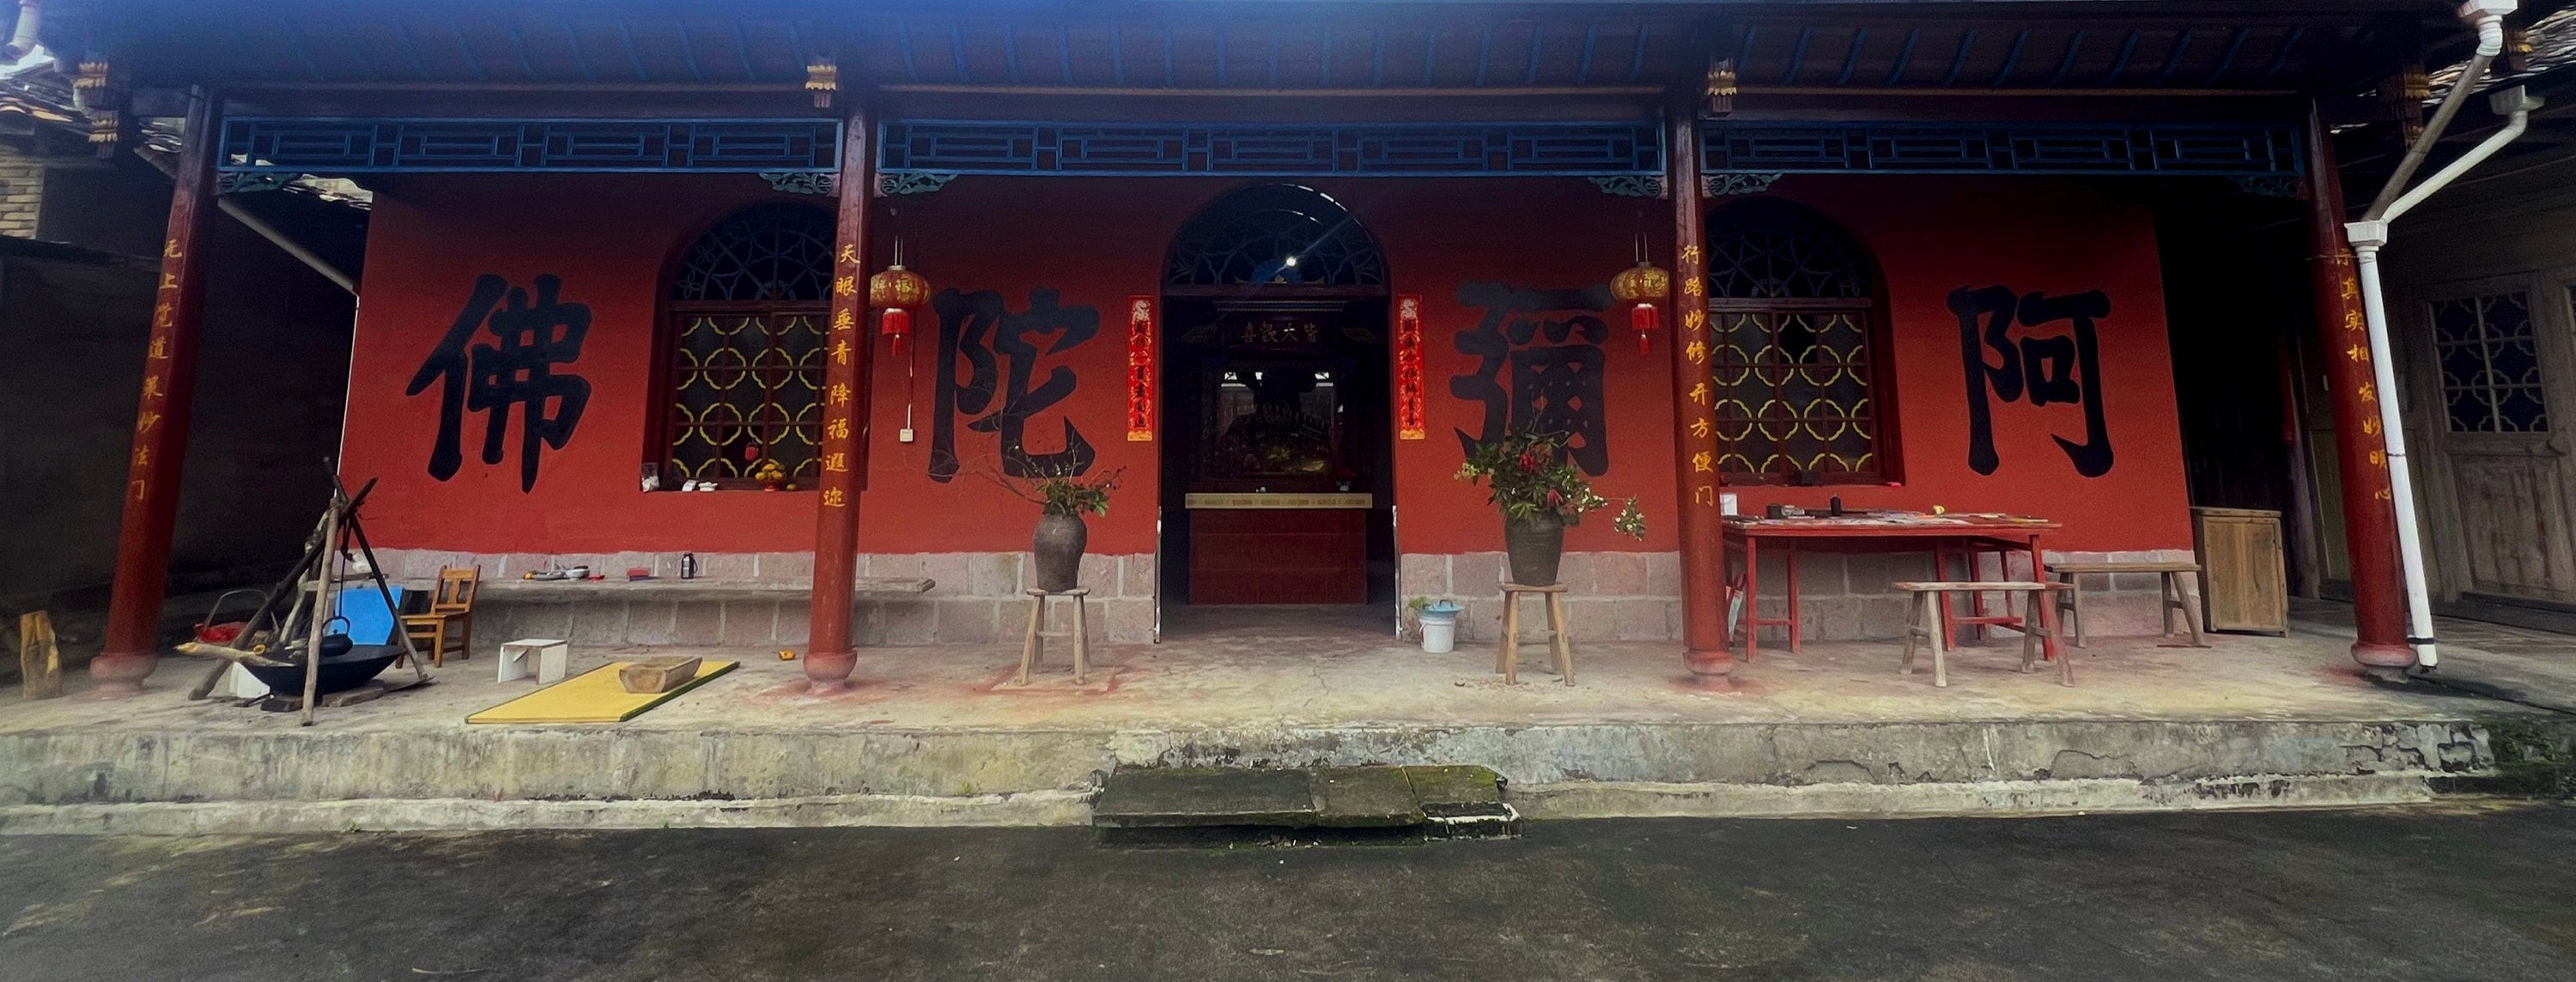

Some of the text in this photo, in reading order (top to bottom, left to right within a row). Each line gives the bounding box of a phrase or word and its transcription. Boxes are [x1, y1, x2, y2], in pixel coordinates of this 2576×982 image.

[405, 273, 592, 494] 佛
[927, 287, 1101, 483] 陀
[1947, 285, 2115, 478] 阿
